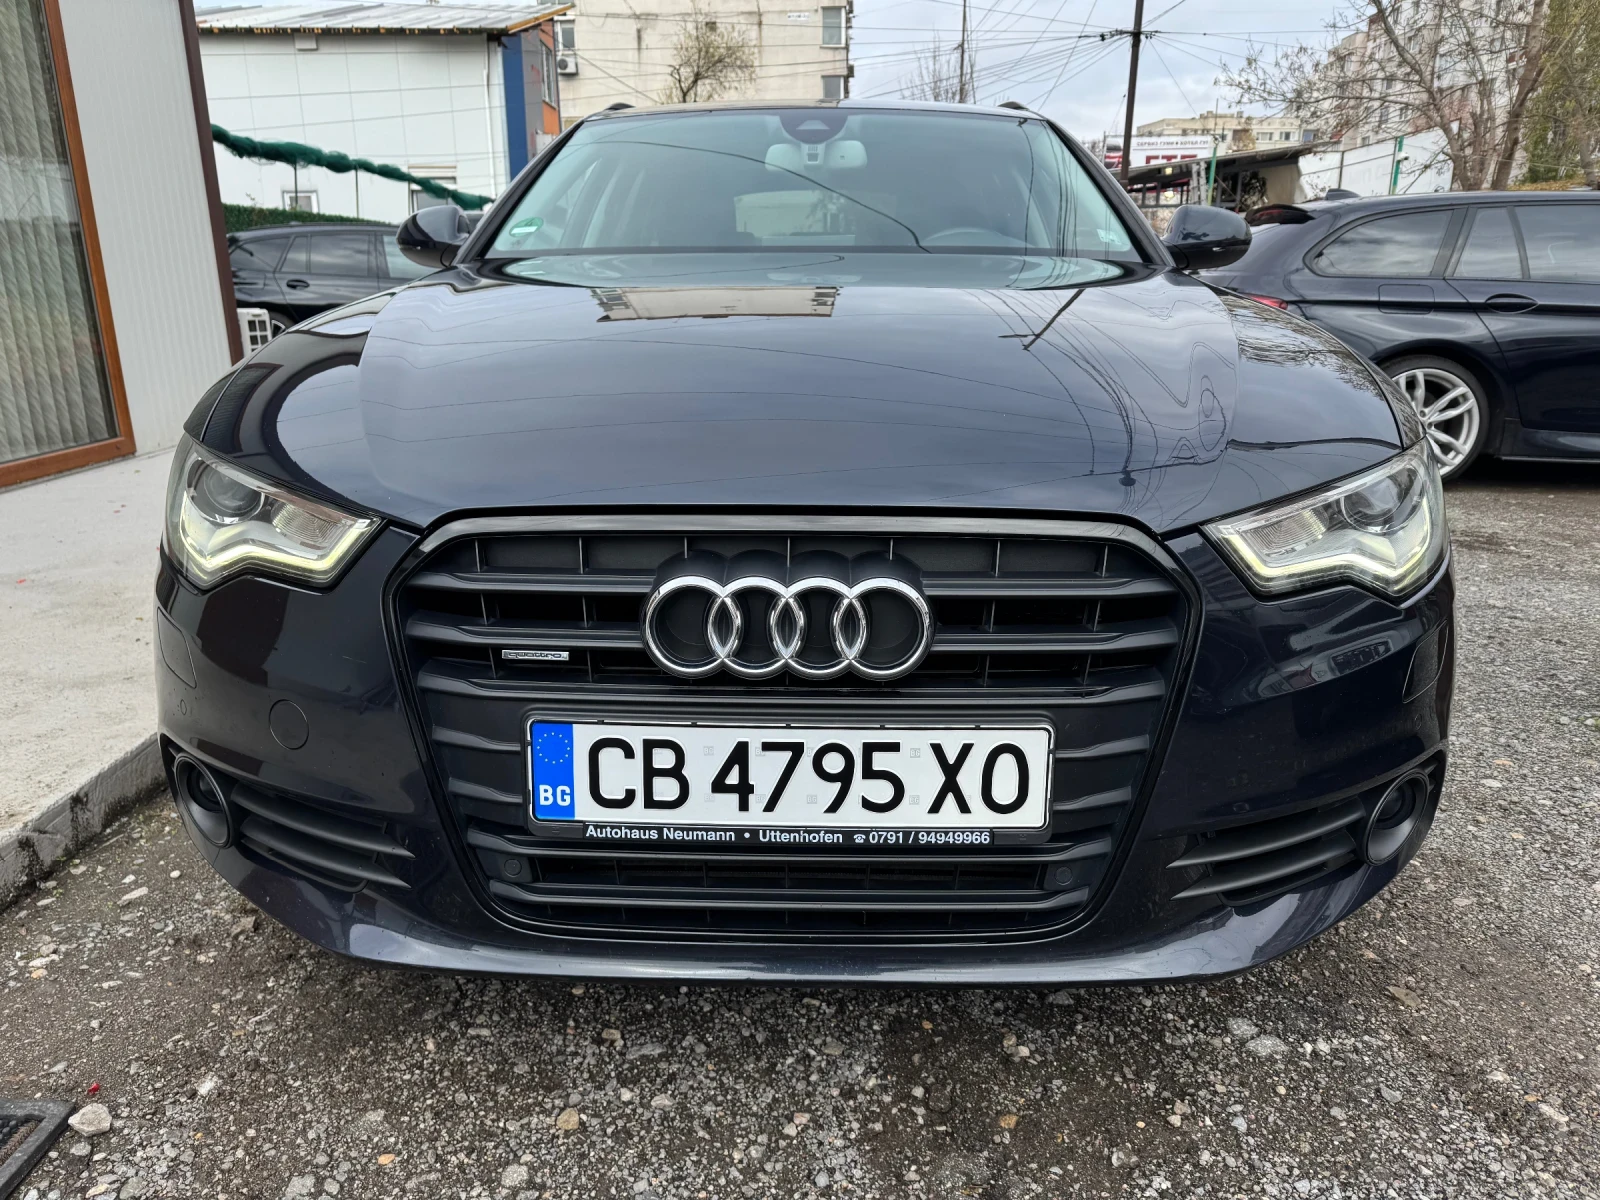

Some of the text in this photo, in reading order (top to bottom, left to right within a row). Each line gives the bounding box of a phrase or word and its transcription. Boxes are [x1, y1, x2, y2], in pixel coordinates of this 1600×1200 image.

[508, 651, 562, 660] quattro
[588, 737, 1030, 815] CB 4795 XO
[538, 784, 571, 807] BG
[585, 824, 659, 840] Autohaus
[663, 827, 736, 842] Neumann
[759, 829, 844, 844] Uttenhofen
[868, 831, 903, 844] 0791
[918, 831, 990, 844] 94949966
